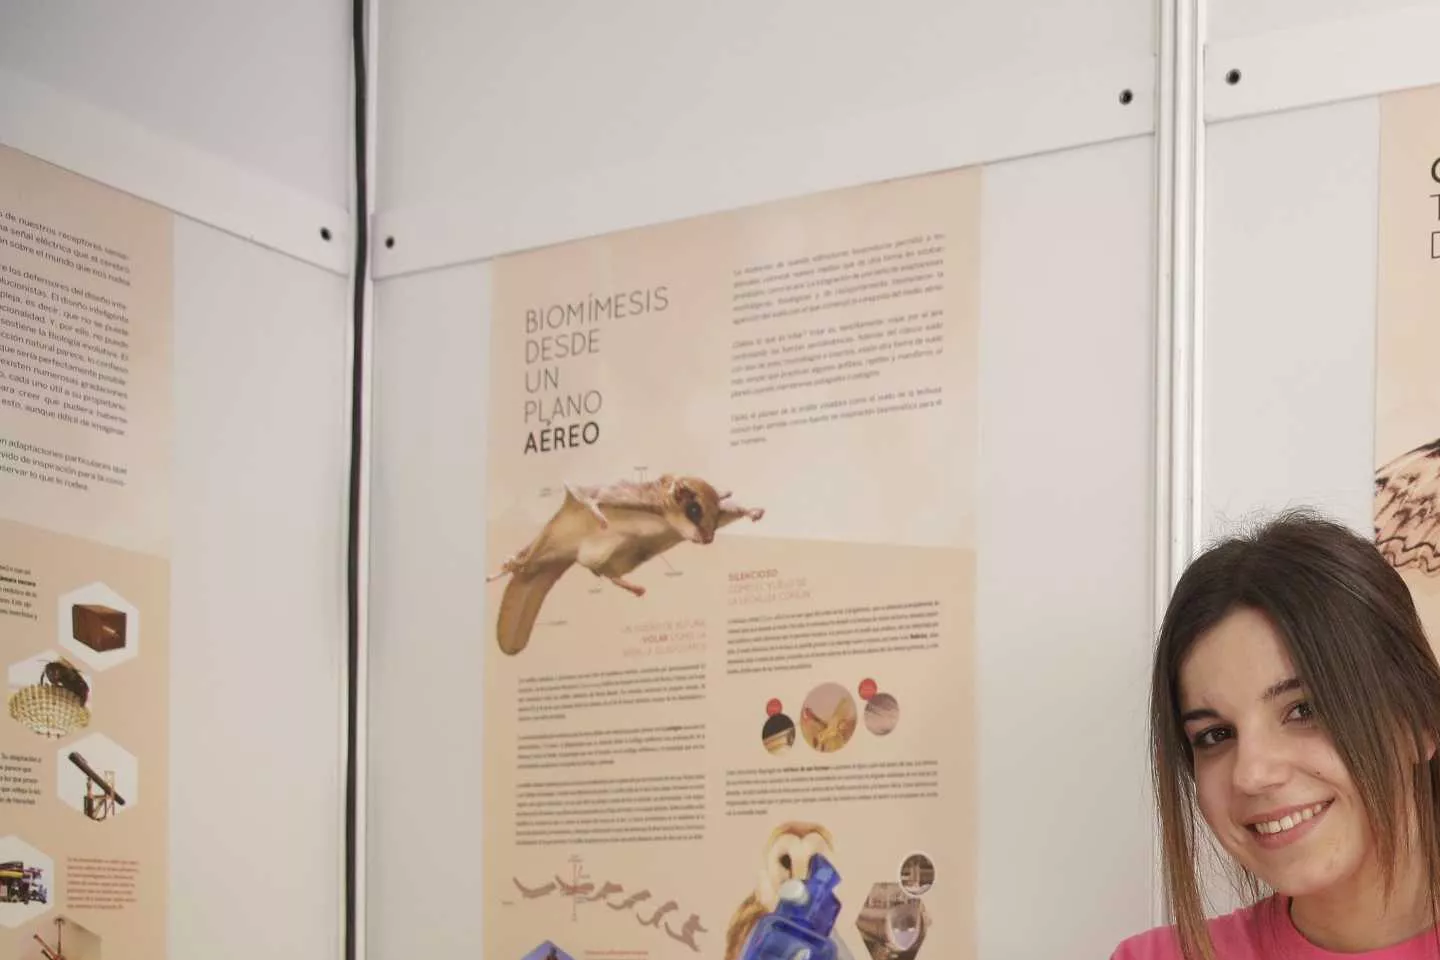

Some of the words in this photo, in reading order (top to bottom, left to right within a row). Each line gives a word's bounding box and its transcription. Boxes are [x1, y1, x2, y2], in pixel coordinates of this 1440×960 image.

[45, 253, 74, 268] mundo
[525, 286, 669, 334] BIOMÍMESIS
[526, 328, 600, 365] DESDE
[526, 366, 559, 393] UN
[524, 390, 603, 424] PLANO
[524, 419, 600, 455] AÉREO
